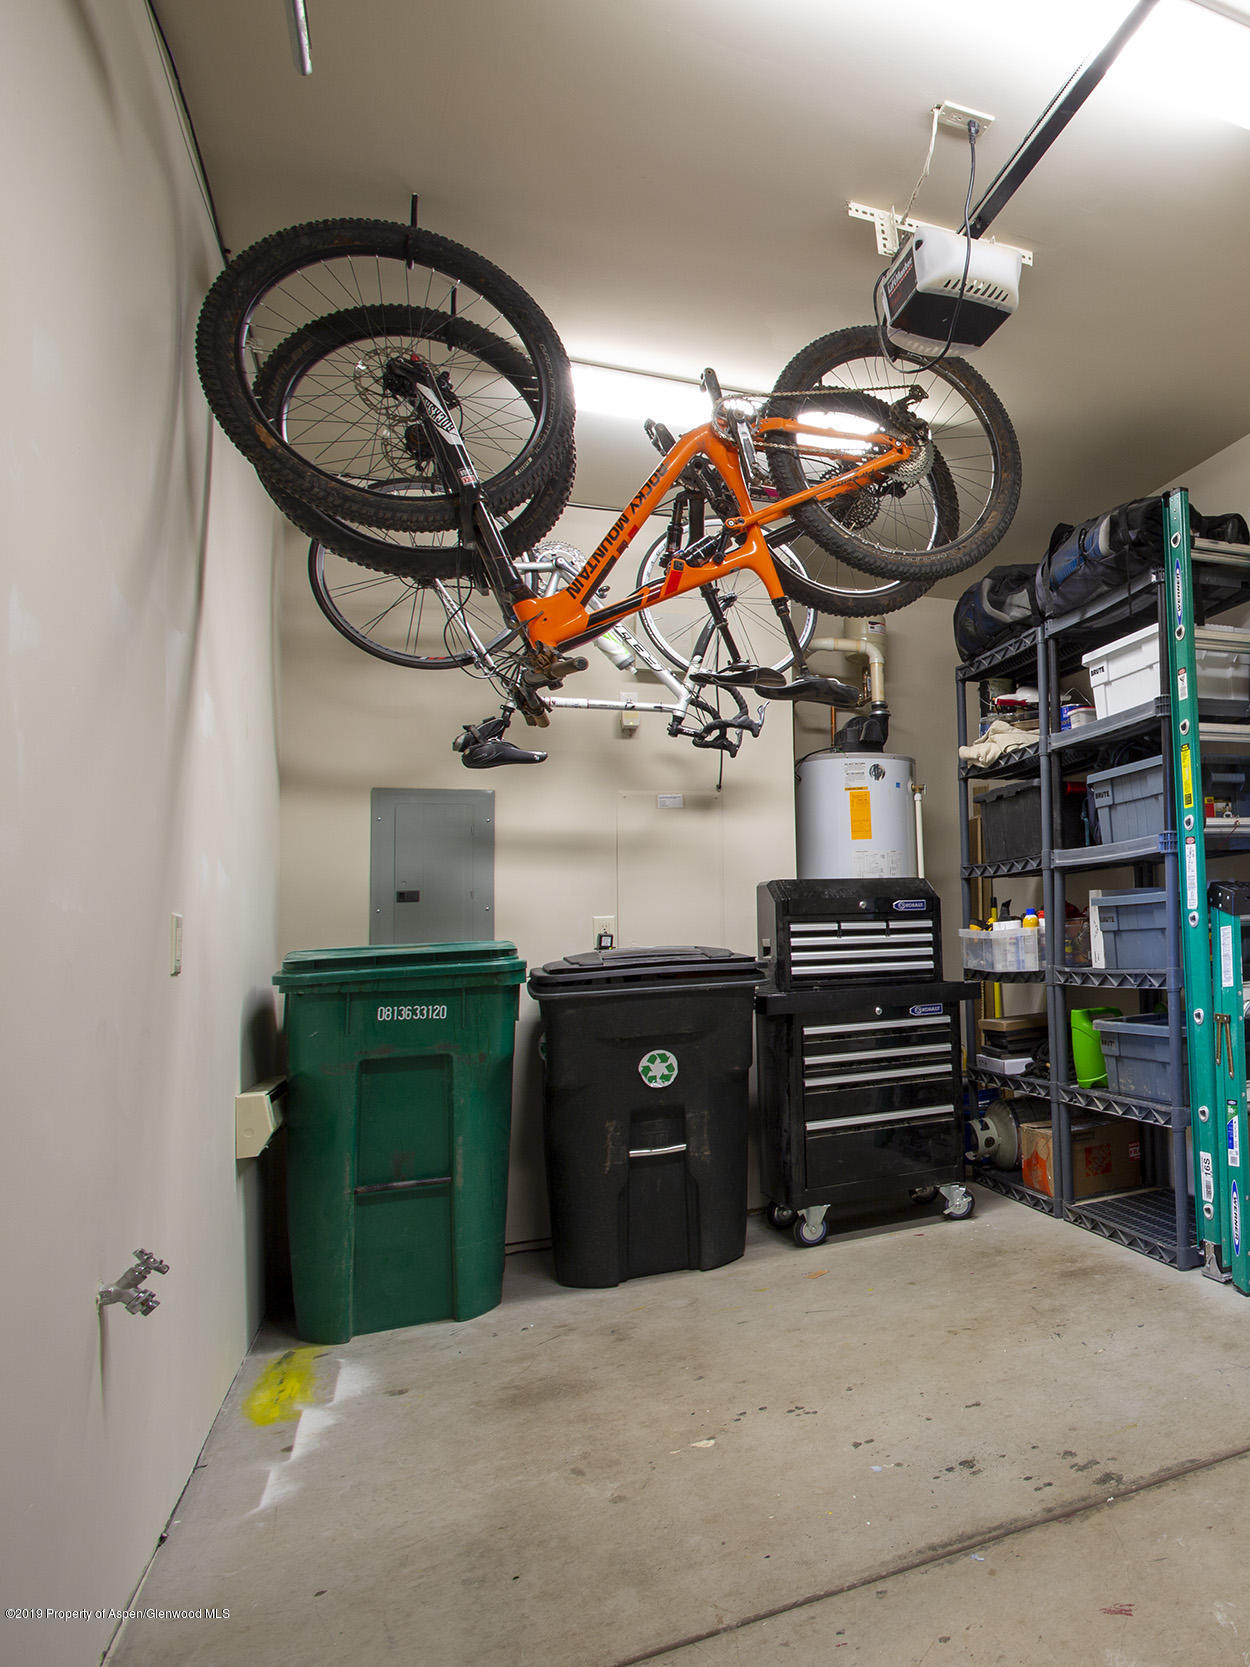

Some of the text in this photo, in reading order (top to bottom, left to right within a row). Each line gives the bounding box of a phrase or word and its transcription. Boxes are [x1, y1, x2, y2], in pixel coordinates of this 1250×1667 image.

[566, 459, 671, 600] ROCKY MOUNTAIN
[1090, 666, 1105, 677] BRUTE
[377, 1005, 447, 1021] 0813633120
